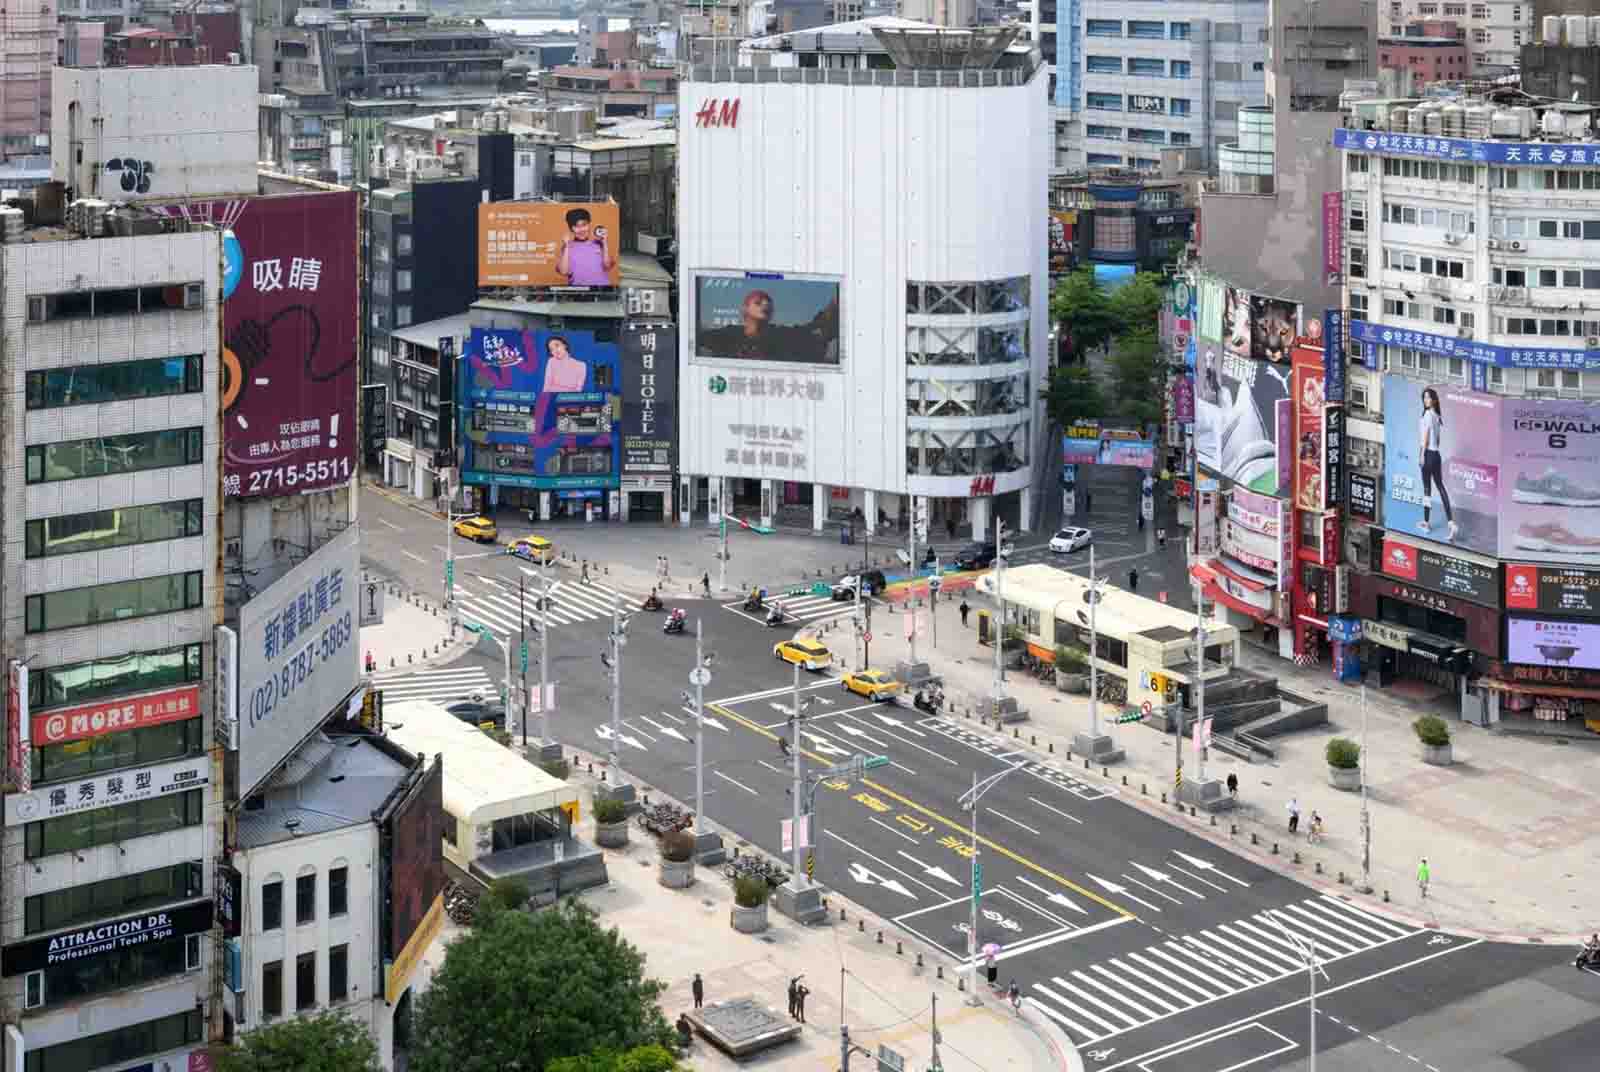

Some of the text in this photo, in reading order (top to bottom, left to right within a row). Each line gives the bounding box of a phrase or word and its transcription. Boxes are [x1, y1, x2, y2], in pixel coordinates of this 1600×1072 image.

[696, 97, 741, 128] H&M
[252, 257, 322, 292] 吸睛
[640, 373, 656, 434] HOTEL
[1549, 434, 1567, 449] 6
[249, 456, 349, 492] 2715-5511
[71, 704, 135, 734] MORE
[48, 928, 173, 963] Professional Teeth Spa
[49, 913, 172, 951] ATTRACTION DR.
